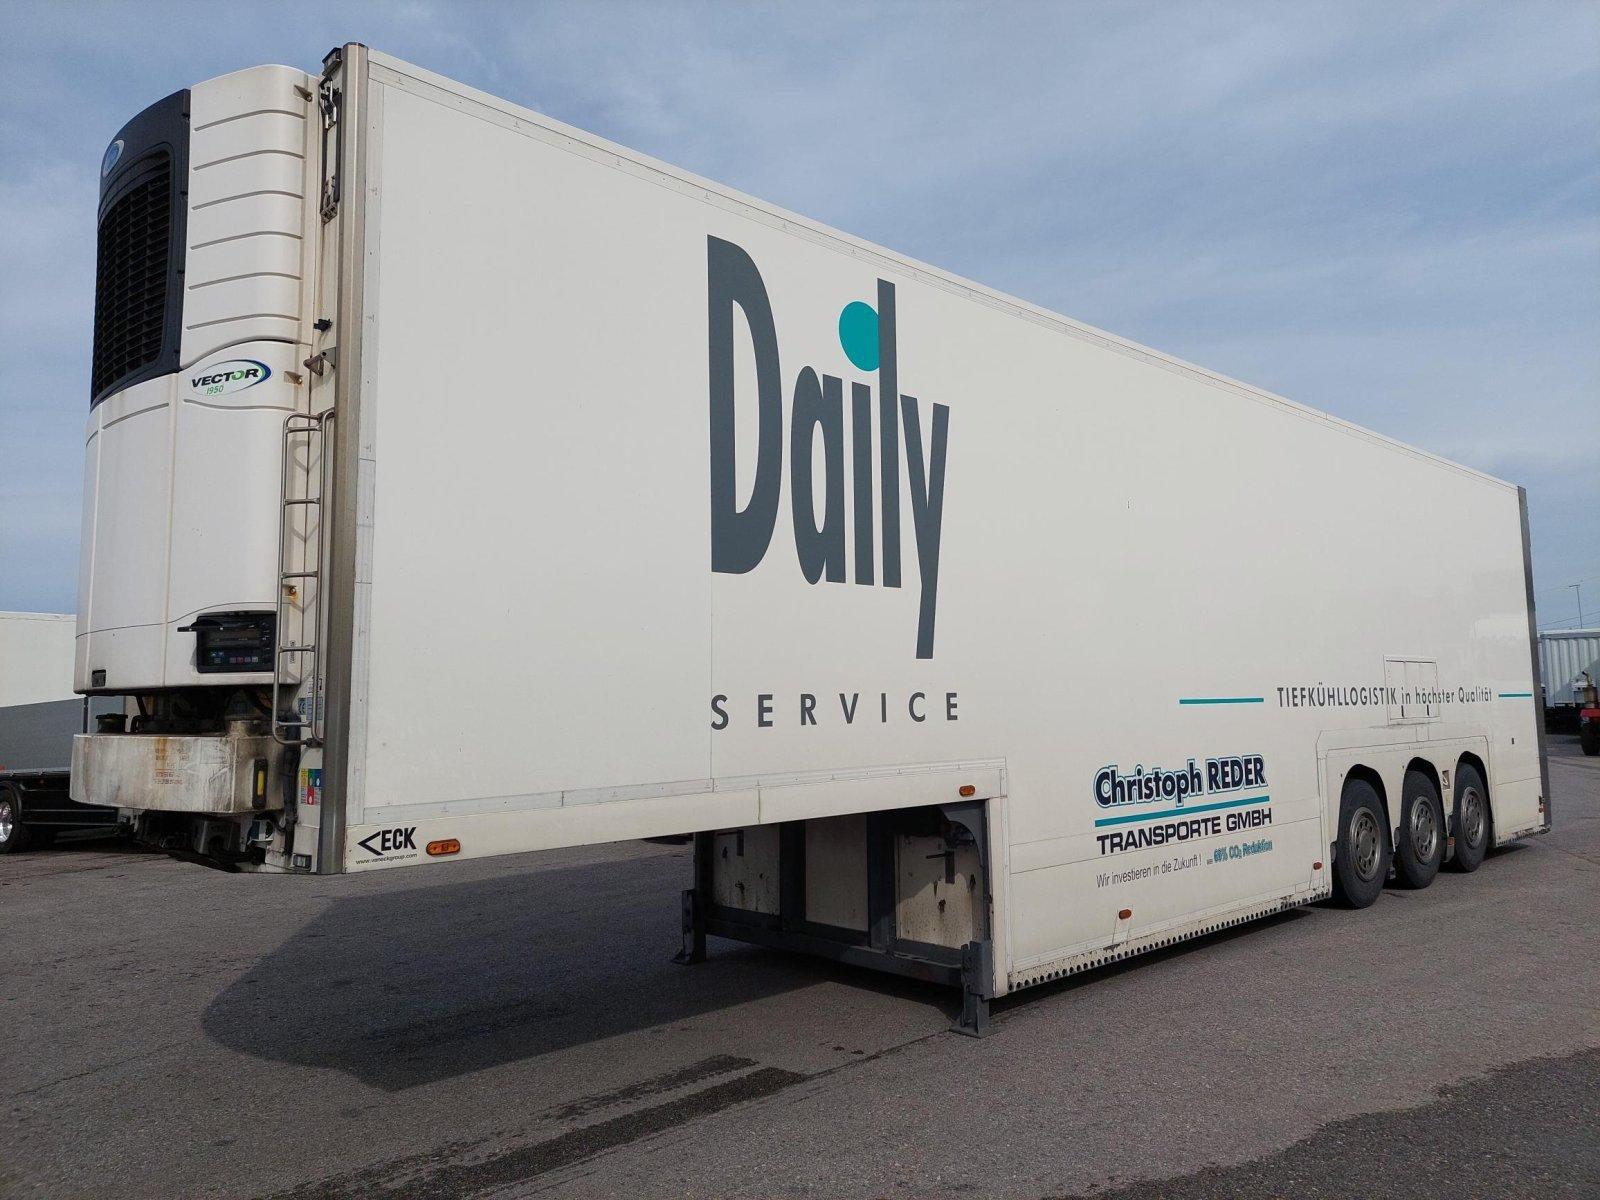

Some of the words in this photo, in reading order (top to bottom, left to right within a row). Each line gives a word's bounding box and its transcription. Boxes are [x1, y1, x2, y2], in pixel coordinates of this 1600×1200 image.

[191, 368, 260, 388] VECTOR
[707, 234, 950, 660] Daily
[710, 692, 960, 730] SERVICE
[1277, 682, 1397, 707] TIEFKÜHLLOGISTIK
[1401, 687, 1411, 704] in
[1415, 687, 1455, 704] höchster
[1458, 686, 1492, 704] Qualität
[1094, 759, 1203, 808] Christoph
[1206, 754, 1268, 794] REDER
[1097, 816, 1221, 855] TRANSPORTE
[1226, 808, 1272, 832] GMBH
[1096, 873, 1110, 888] Wir
[1111, 867, 1152, 885] investieren
[1161, 860, 1172, 874] die
